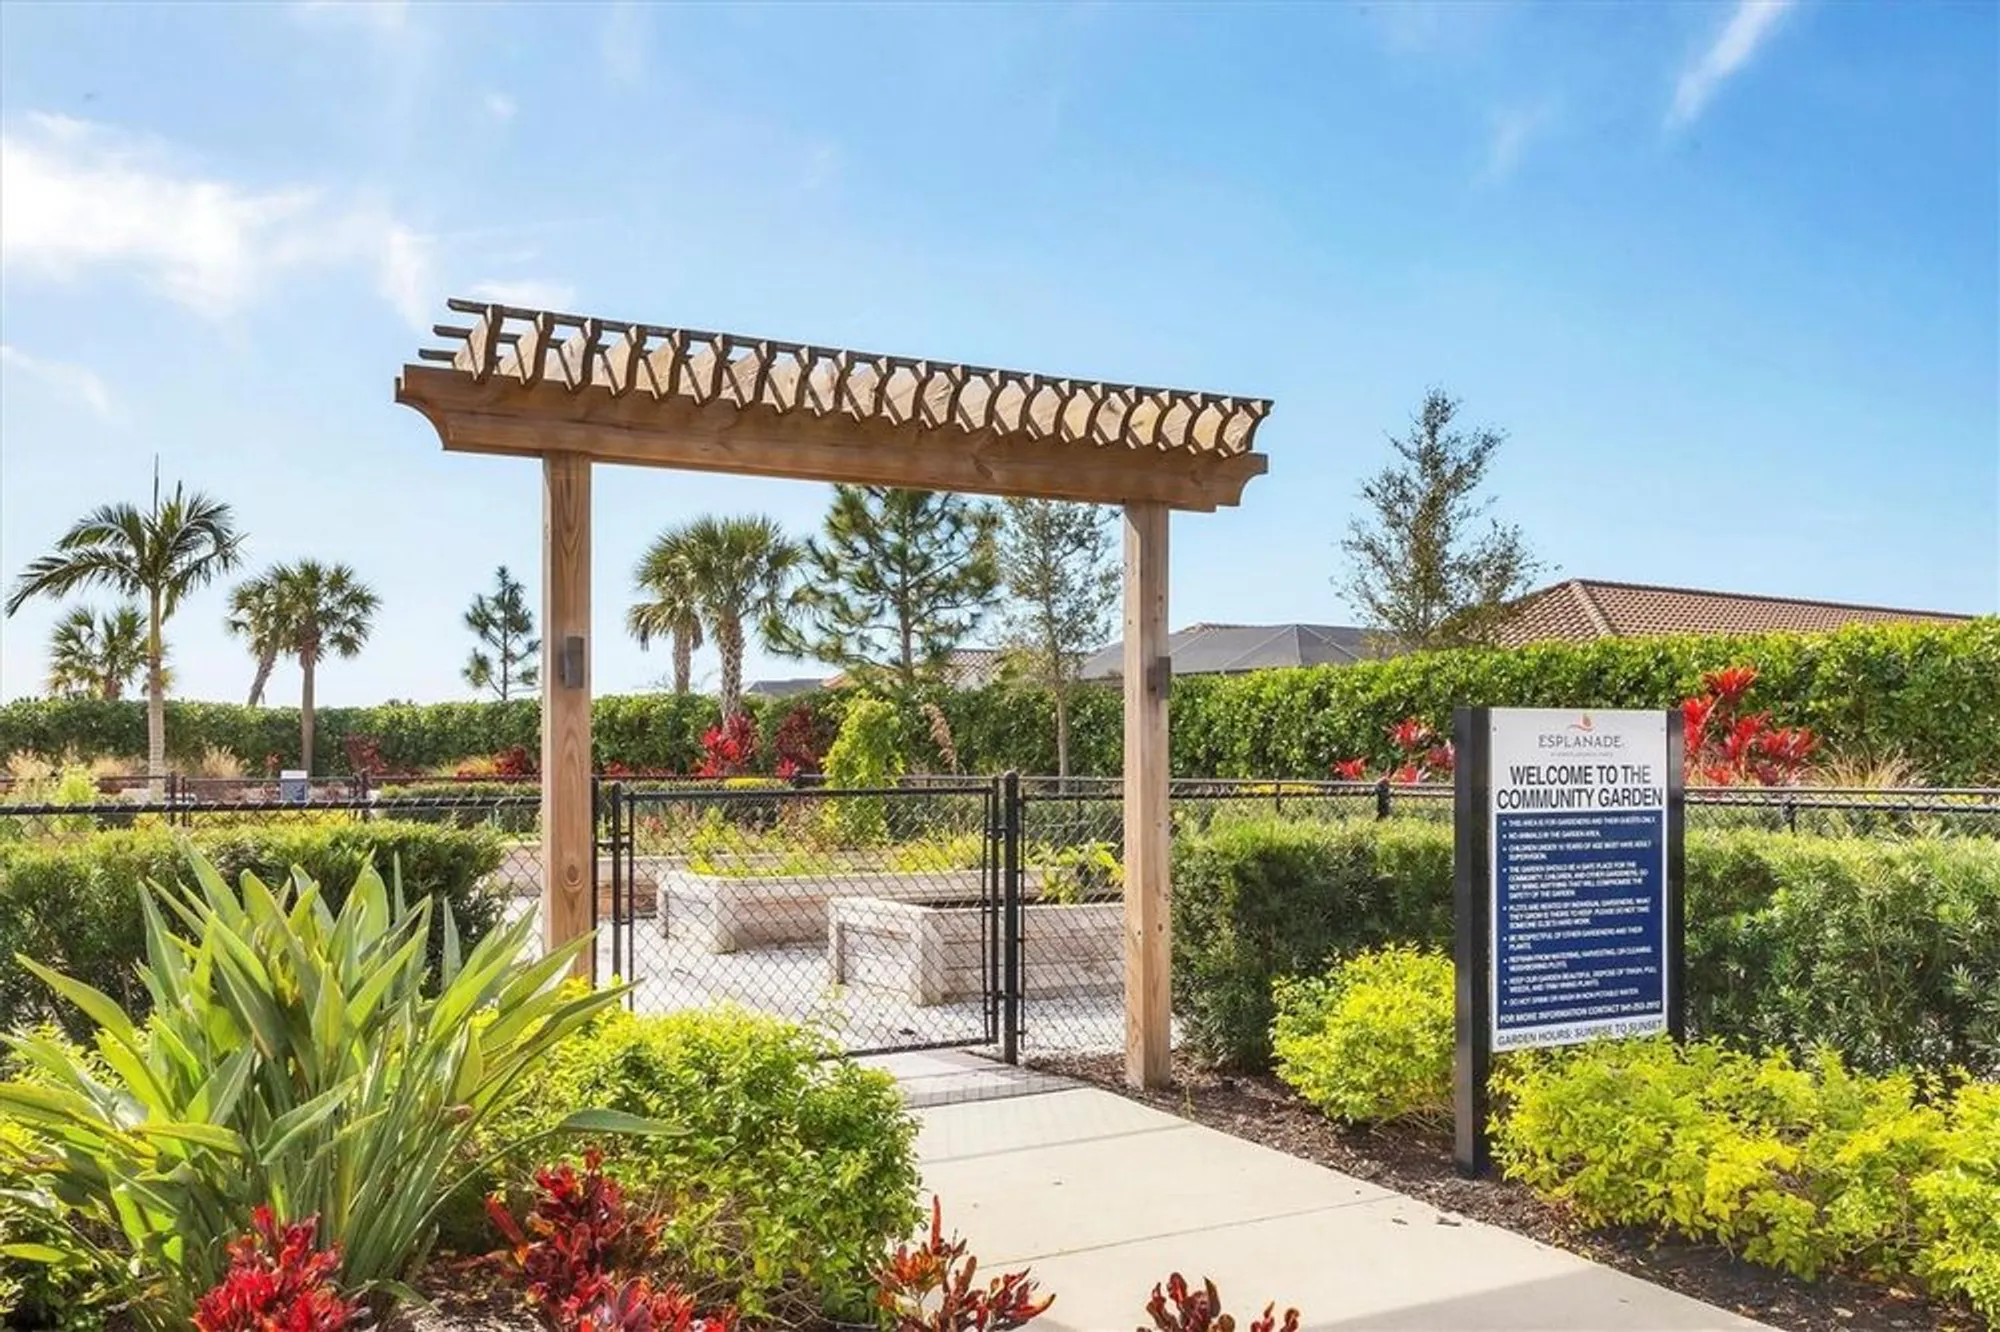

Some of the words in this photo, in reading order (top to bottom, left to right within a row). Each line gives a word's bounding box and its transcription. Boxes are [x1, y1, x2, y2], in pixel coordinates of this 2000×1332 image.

[1538, 735, 1623, 748] ESPLANADE
[1510, 765, 1593, 785] WELCOME
[1597, 765, 1618, 784] TO
[1621, 765, 1651, 784] THE
[1497, 789, 1595, 809] COMMUNITY
[1598, 787, 1663, 807] GARDEN
[1497, 1033, 1536, 1046] GARDEN
[1615, 1024, 1627, 1034] TO
[1629, 1020, 1663, 1033] SUNSET
